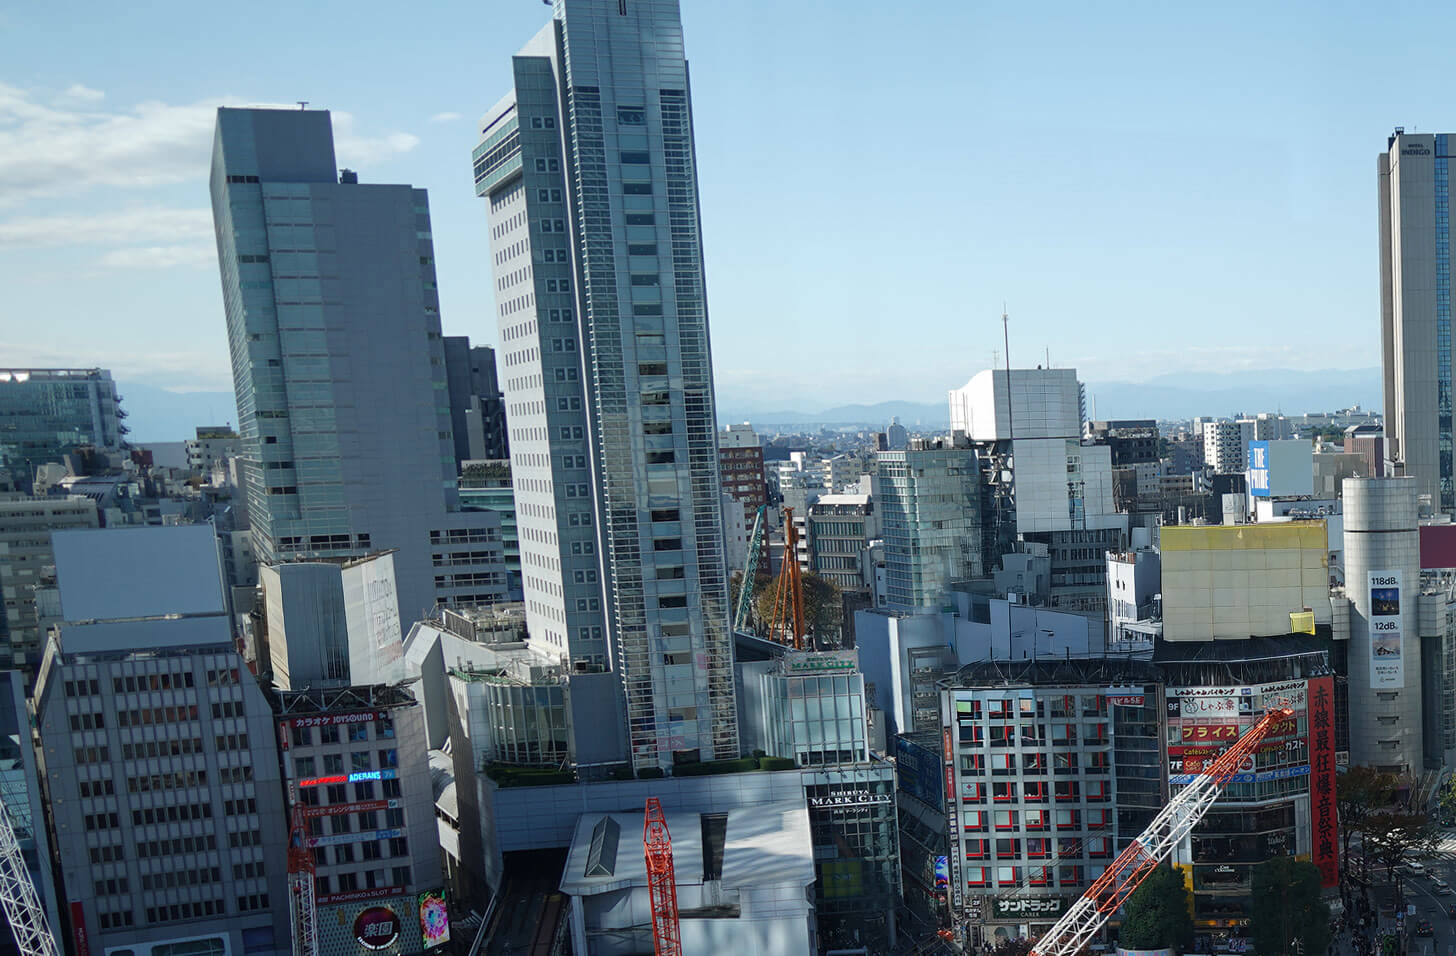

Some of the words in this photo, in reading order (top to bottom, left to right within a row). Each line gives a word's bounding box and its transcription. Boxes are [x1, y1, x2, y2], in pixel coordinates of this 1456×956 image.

[1168, 702, 1179, 711] 9F
[296, 717, 331, 728] カラオケ
[332, 713, 374, 724] JOYSOUND
[1285, 740, 1305, 751] ガスト
[1170, 760, 1183, 770] 7F
[348, 770, 381, 783] ADERANS
[830, 789, 870, 797] SHIBUYA
[811, 796, 853, 806] MARK
[858, 794, 891, 802] CITY
[999, 899, 1060, 912] サンドラッグ
[364, 921, 393, 937] 楽園
